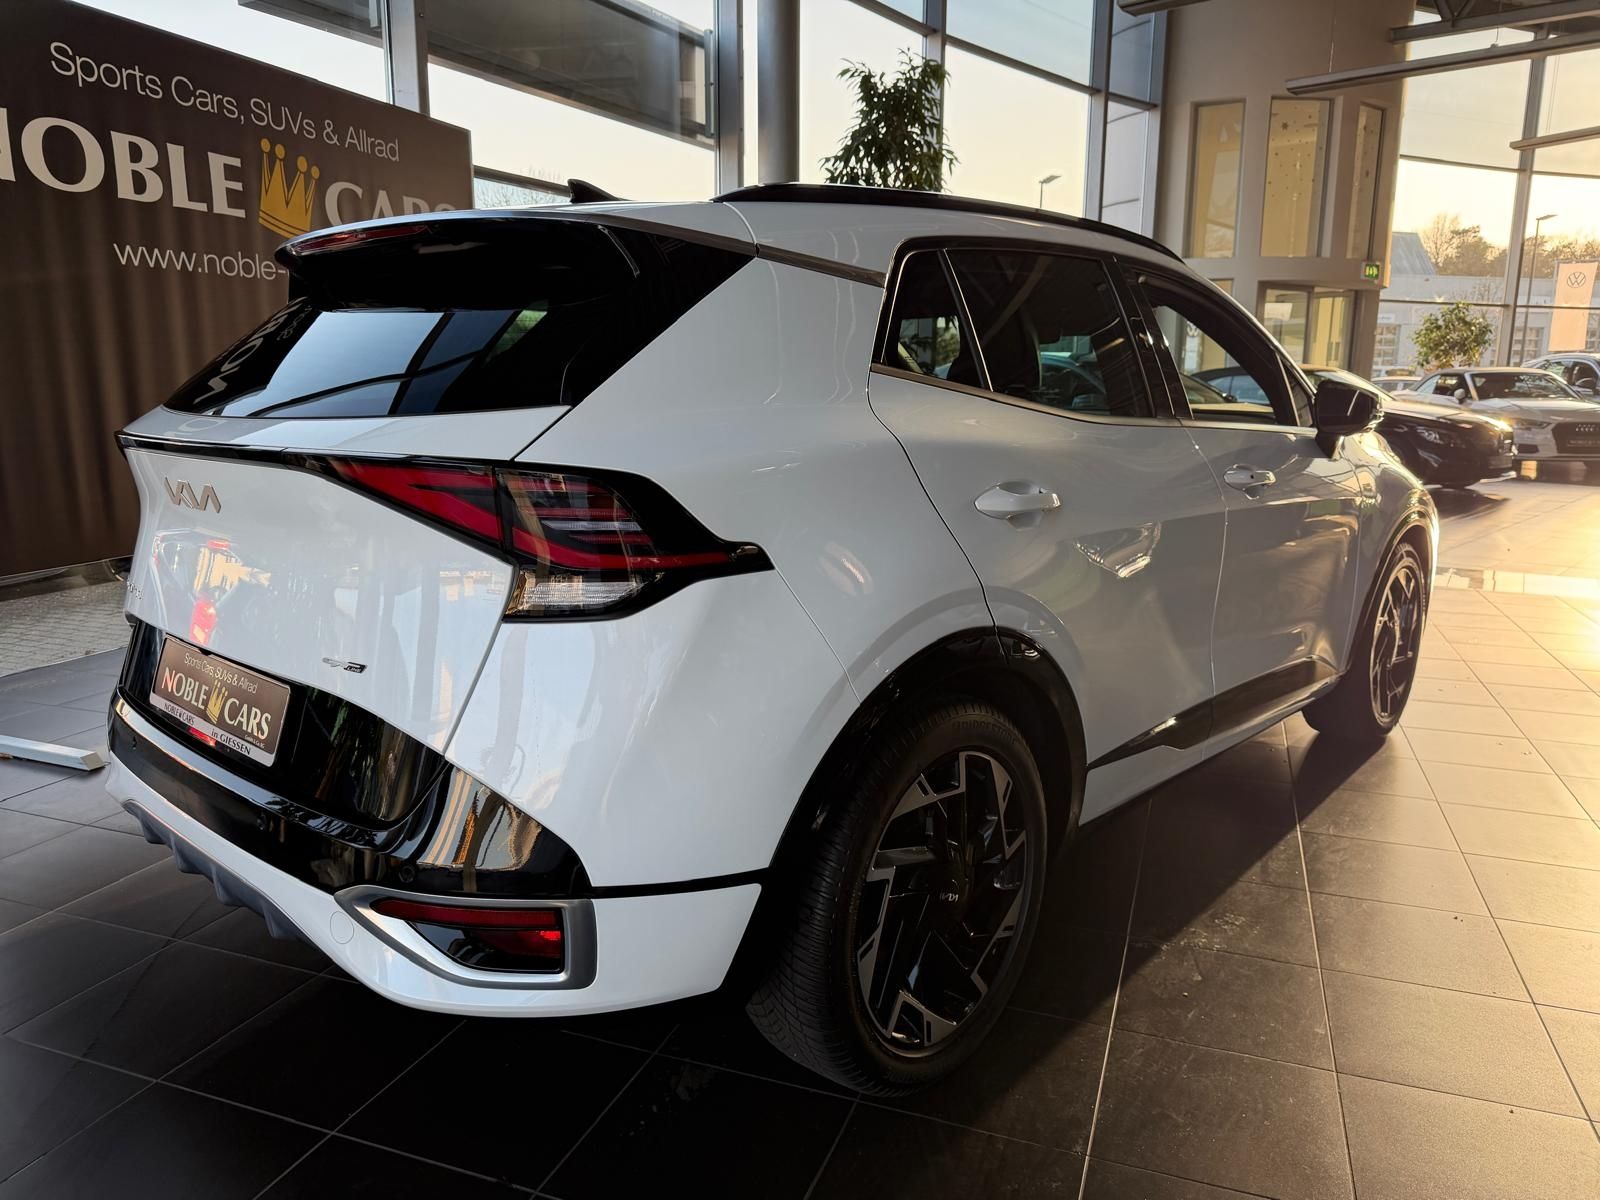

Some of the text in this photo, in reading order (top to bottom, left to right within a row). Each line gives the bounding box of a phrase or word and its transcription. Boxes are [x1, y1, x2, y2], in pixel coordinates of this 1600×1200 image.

[51, 42, 400, 162] Sports Cars, SUVs & Allrad
[0, 107, 246, 219] OBLE
[113, 243, 289, 281] www.noble-
[165, 477, 222, 513] KIA
[161, 667, 271, 740] NOBLE CARS
[211, 728, 218, 738] in
[220, 733, 251, 756] GIESSEN
